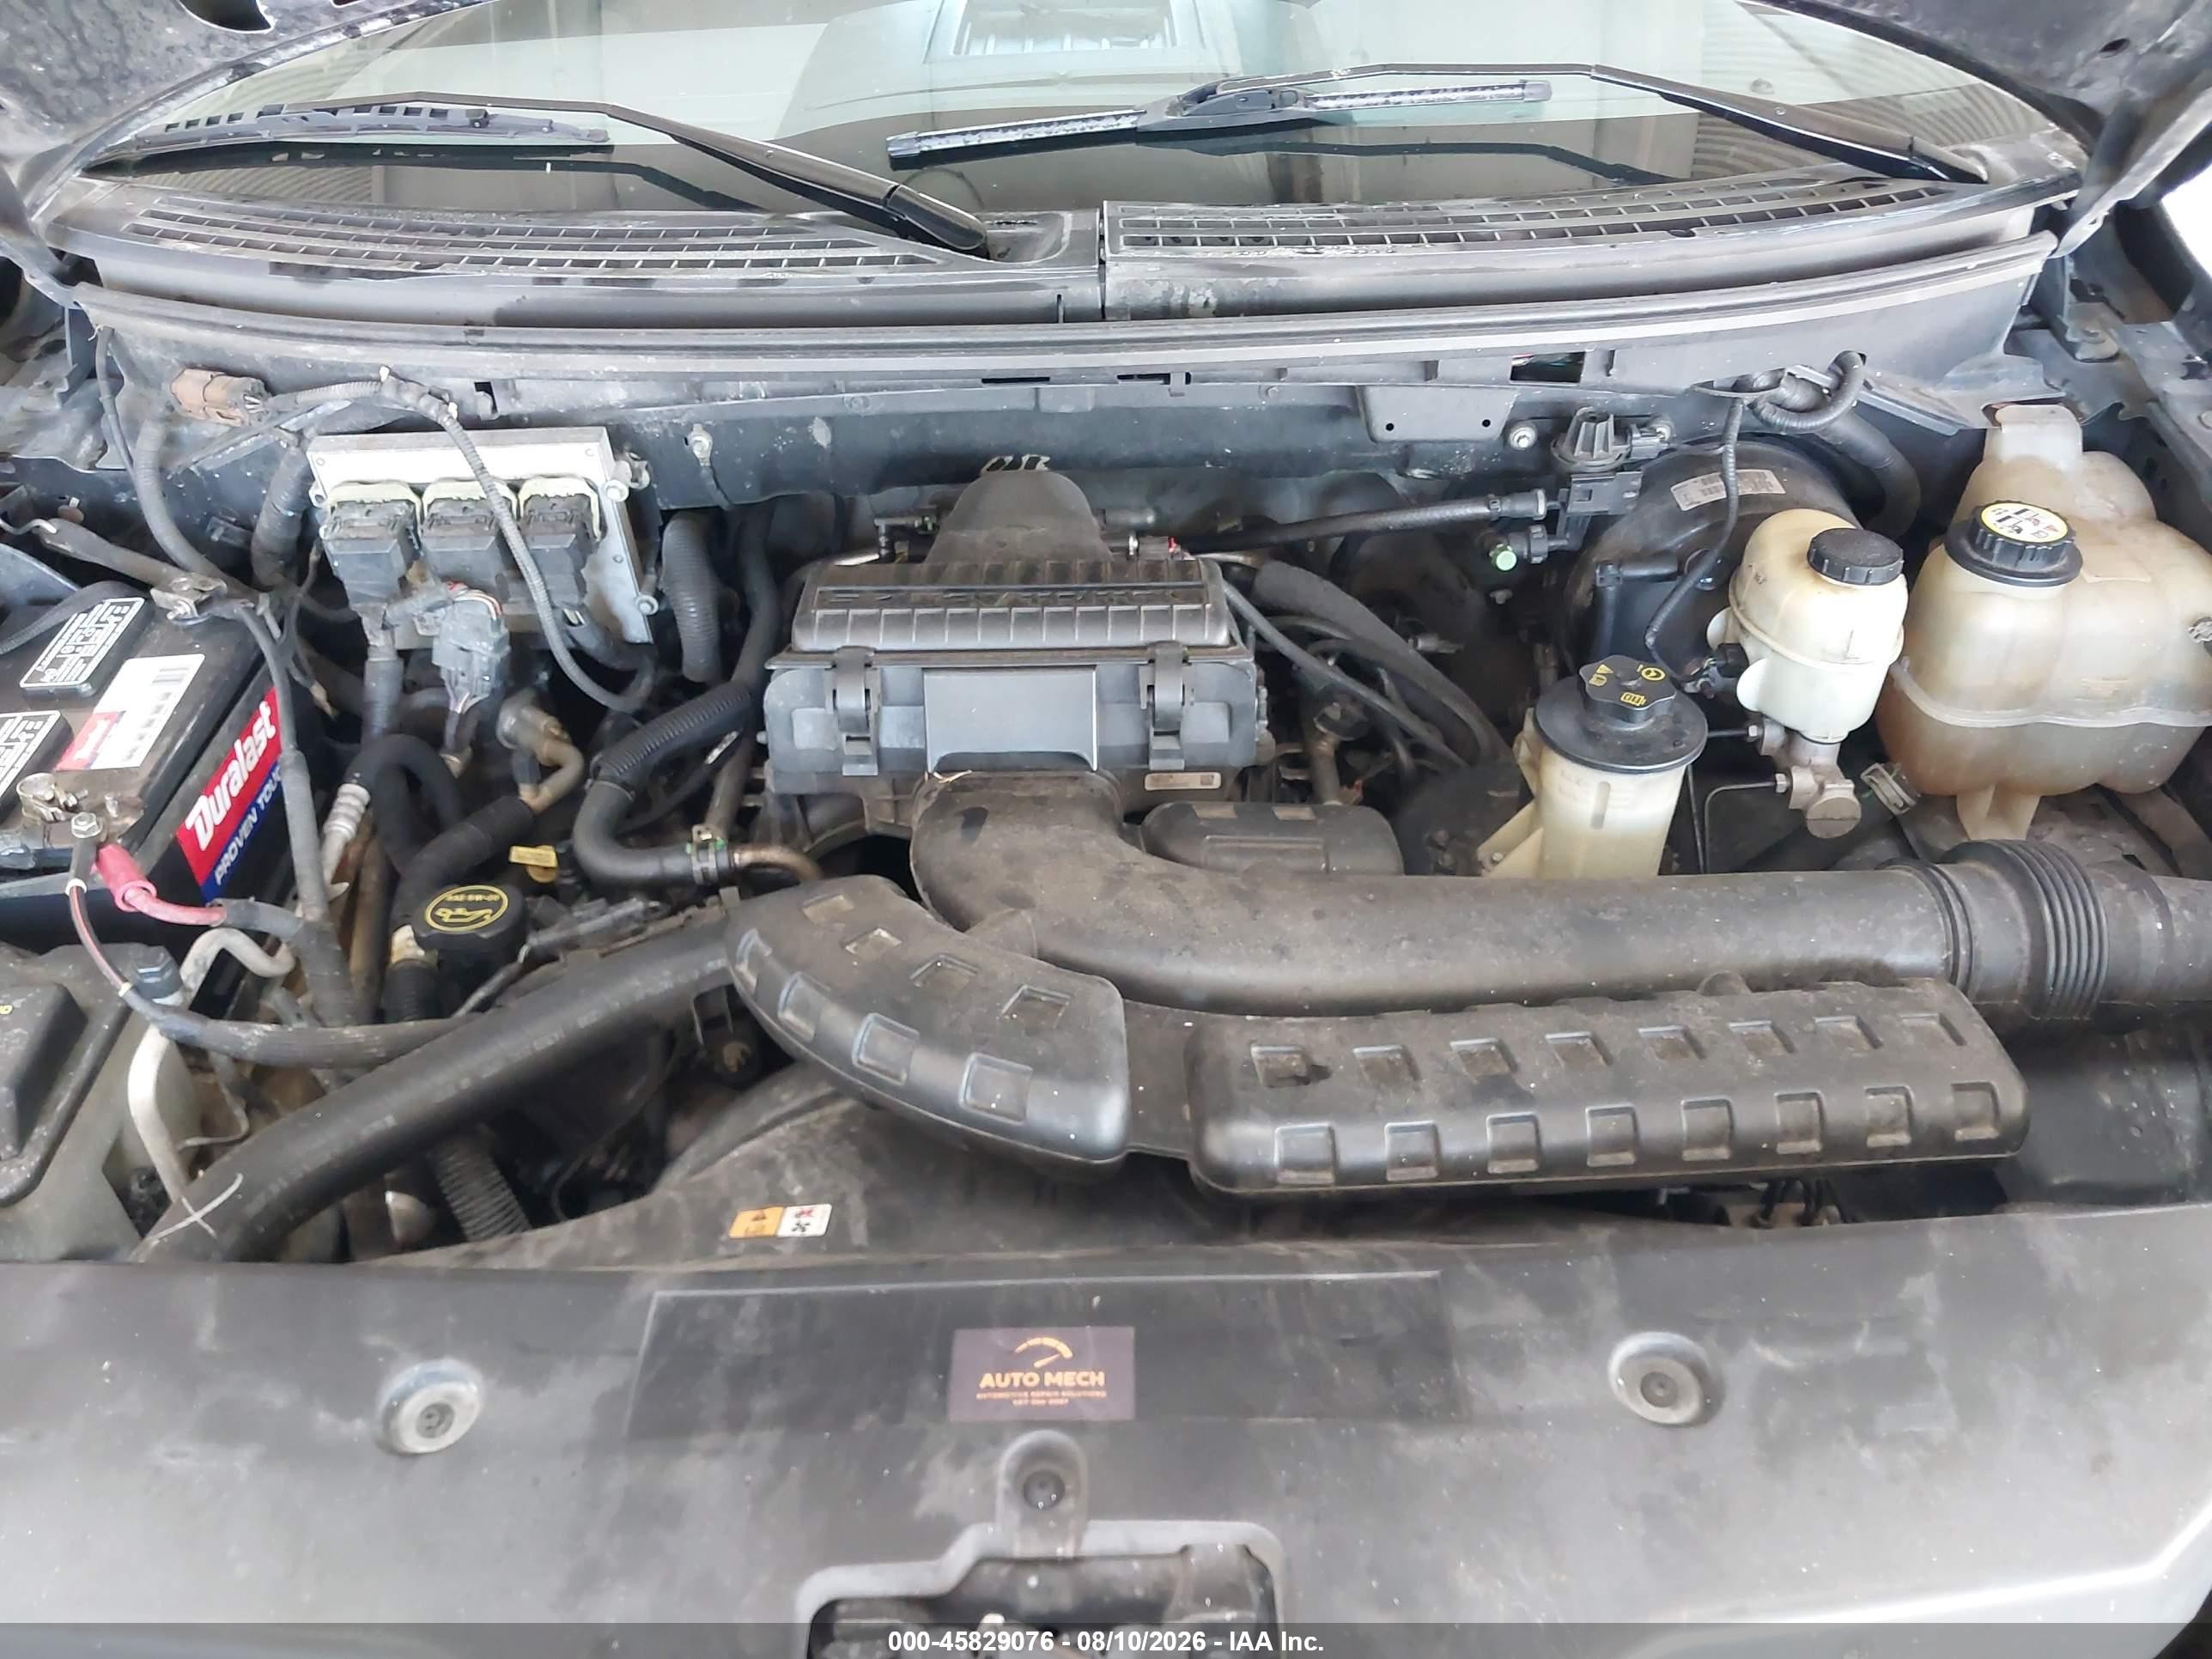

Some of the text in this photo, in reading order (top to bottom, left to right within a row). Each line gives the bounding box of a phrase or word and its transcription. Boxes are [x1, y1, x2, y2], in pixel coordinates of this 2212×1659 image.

[185, 700, 276, 851] Duralast
[215, 807, 258, 885] PROVEN
[979, 1371, 1106, 1389] AUTO MECH
